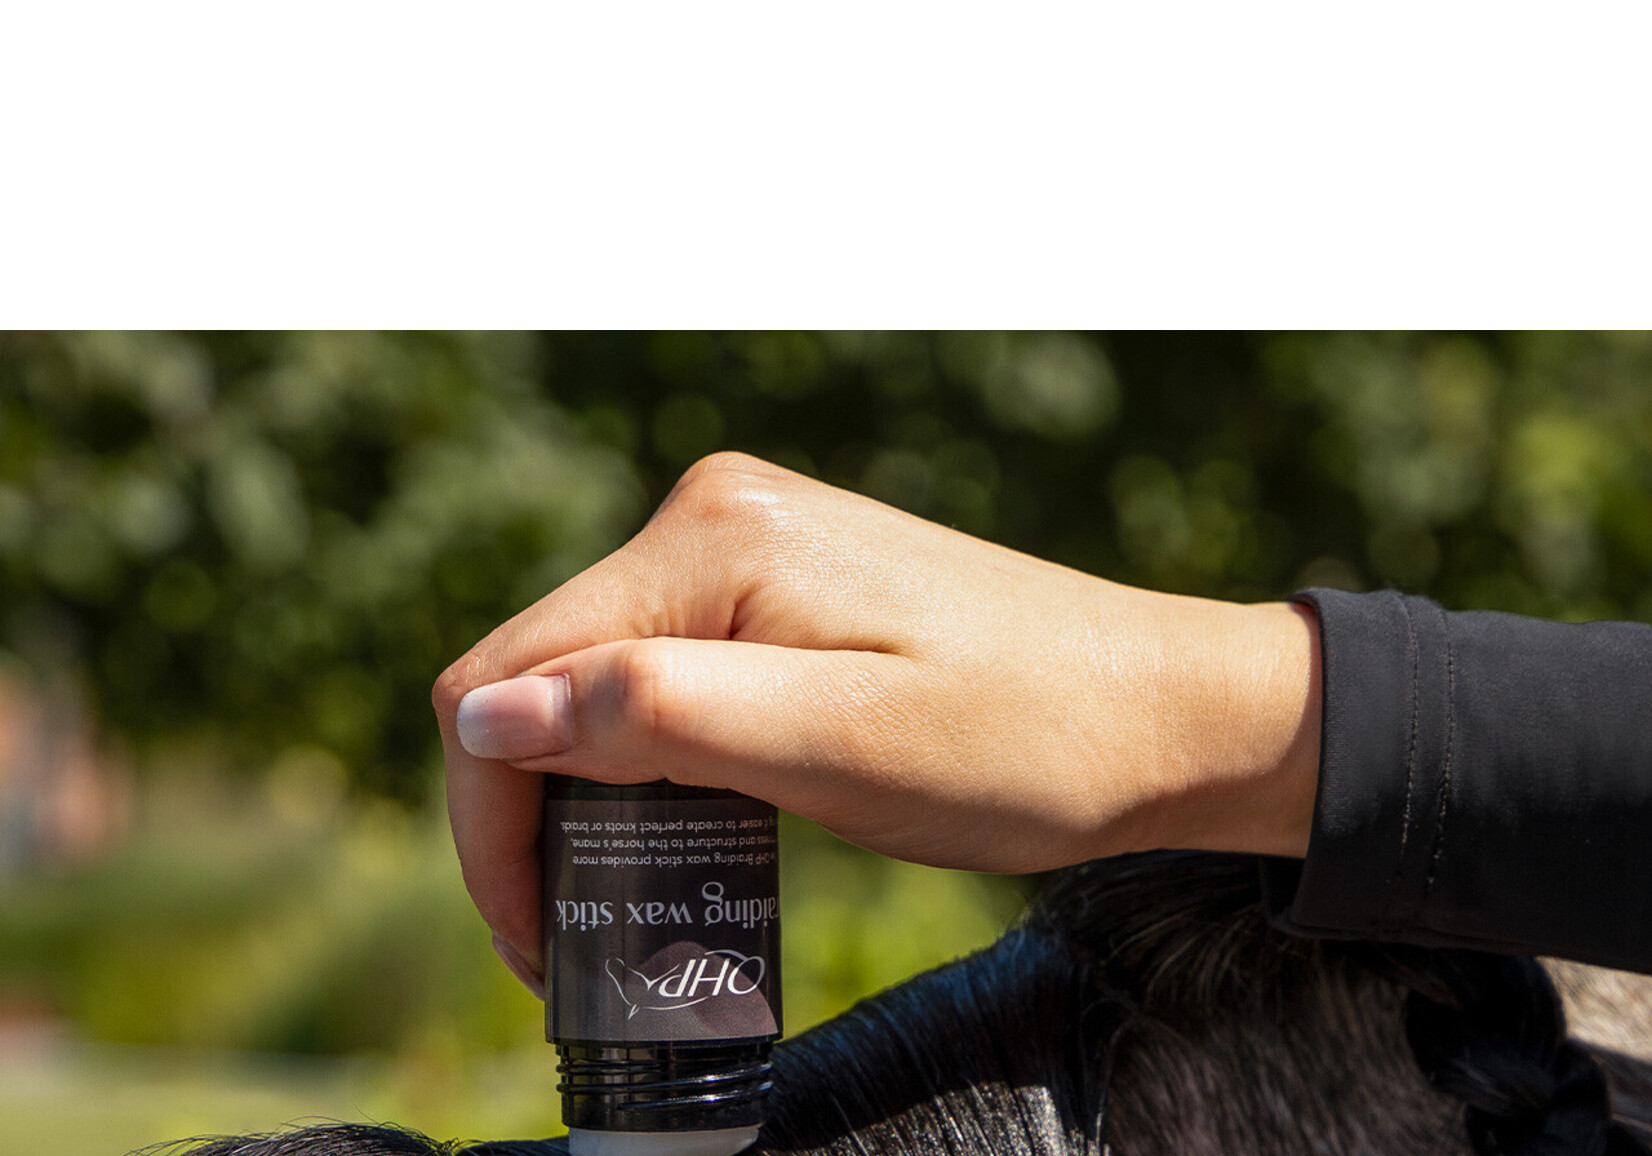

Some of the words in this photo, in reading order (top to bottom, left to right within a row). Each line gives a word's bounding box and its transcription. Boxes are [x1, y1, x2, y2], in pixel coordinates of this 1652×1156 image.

[590, 822, 602, 831] or
[604, 822, 636, 834] knots
[640, 819, 683, 834] perfect
[686, 821, 723, 833] create
[725, 821, 736, 832] to
[738, 819, 763, 830] easier
[570, 838, 601, 848] mane,
[603, 839, 645, 851] horse's
[648, 839, 668, 851] the
[670, 839, 683, 851] to
[687, 837, 737, 849] structure
[739, 836, 756, 848] and
[572, 856, 599, 865] more
[601, 853, 651, 868] provides
[654, 856, 683, 868] stick
[686, 855, 711, 864] wax
[714, 852, 753, 866] Braiding
[555, 900, 614, 931] stick
[626, 901, 693, 925] wax
[658, 949, 766, 998] QHP
